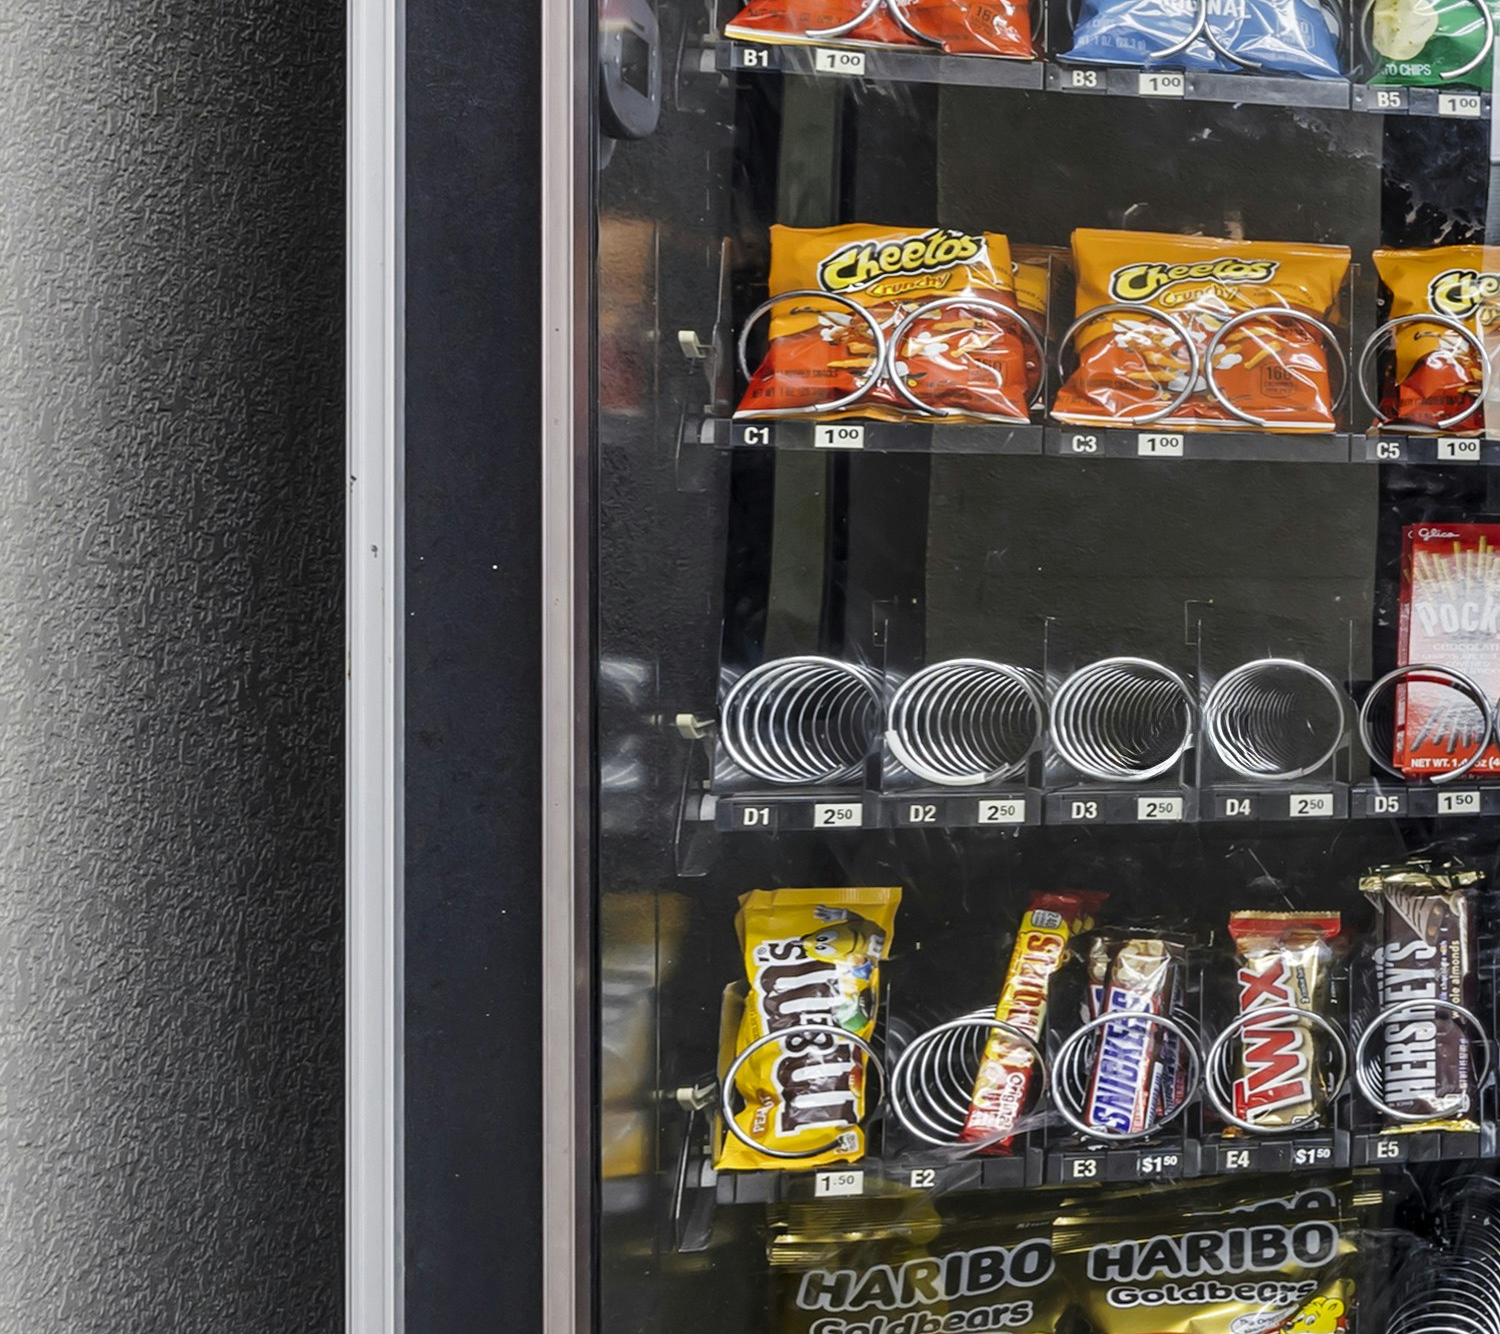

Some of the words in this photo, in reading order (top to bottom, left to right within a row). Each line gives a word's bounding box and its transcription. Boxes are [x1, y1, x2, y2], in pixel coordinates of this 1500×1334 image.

[743, 50, 769, 67] B1
[1377, 92, 1401, 107] B5
[822, 230, 980, 290] Cheetos
[866, 273, 950, 297] Crunchy
[1112, 260, 1277, 300] Cheetos
[744, 426, 770, 444] C1
[1071, 435, 1098, 452] C3
[1376, 442, 1400, 458] C5
[1418, 527, 1460, 541] Glico
[1411, 758, 1432, 769] NET
[1432, 758, 1450, 769] WT.
[1071, 802, 1098, 819] D3
[1375, 795, 1399, 813] D5
[743, 808, 770, 826] D1
[910, 804, 936, 823] D2
[1450, 940, 1460, 985] almonds
[1384, 940, 1437, 1103] HERSHEY'S
[1233, 961, 1306, 1122] TWIX
[1226, 1151, 1250, 1167] E4
[910, 1169, 935, 1188] E2
[1087, 1221, 1340, 1282] HARIBO
[796, 1238, 1057, 1313] HARIBO
[1106, 1280, 1318, 1308] Goldbears
